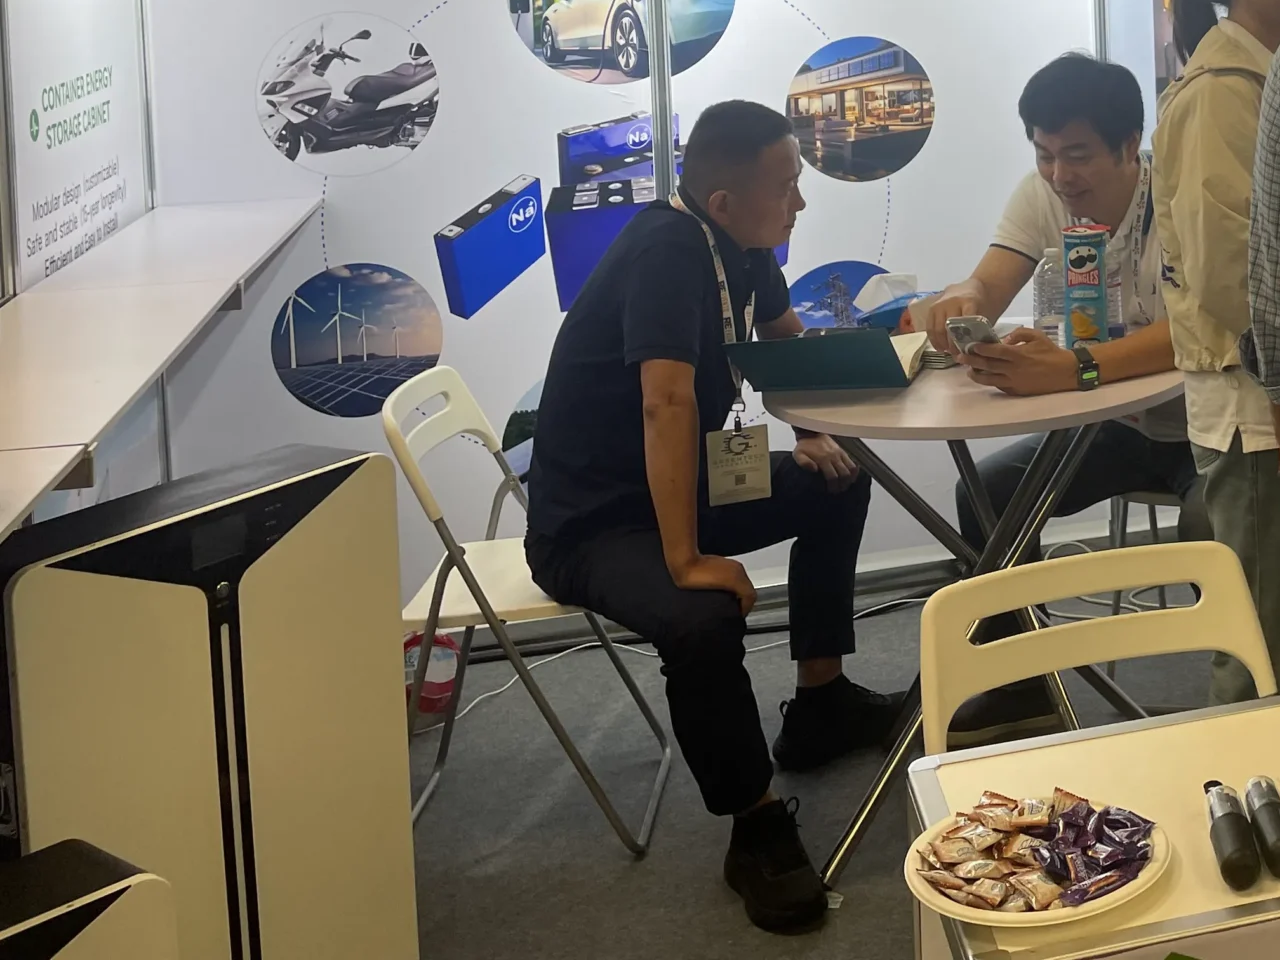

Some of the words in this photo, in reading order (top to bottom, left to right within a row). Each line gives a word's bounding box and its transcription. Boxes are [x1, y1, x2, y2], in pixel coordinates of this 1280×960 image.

[41, 73, 85, 112] CONTAINER
[86, 65, 113, 95] ENERGY
[46, 113, 81, 150] STORAGE
[83, 100, 111, 133] CABINET
[32, 193, 61, 222] Modular
[62, 181, 82, 205] design
[26, 234, 43, 258] Safe
[44, 222, 58, 247] and
[59, 212, 78, 239] stable
[1068, 270, 1099, 286] PRINGLES
